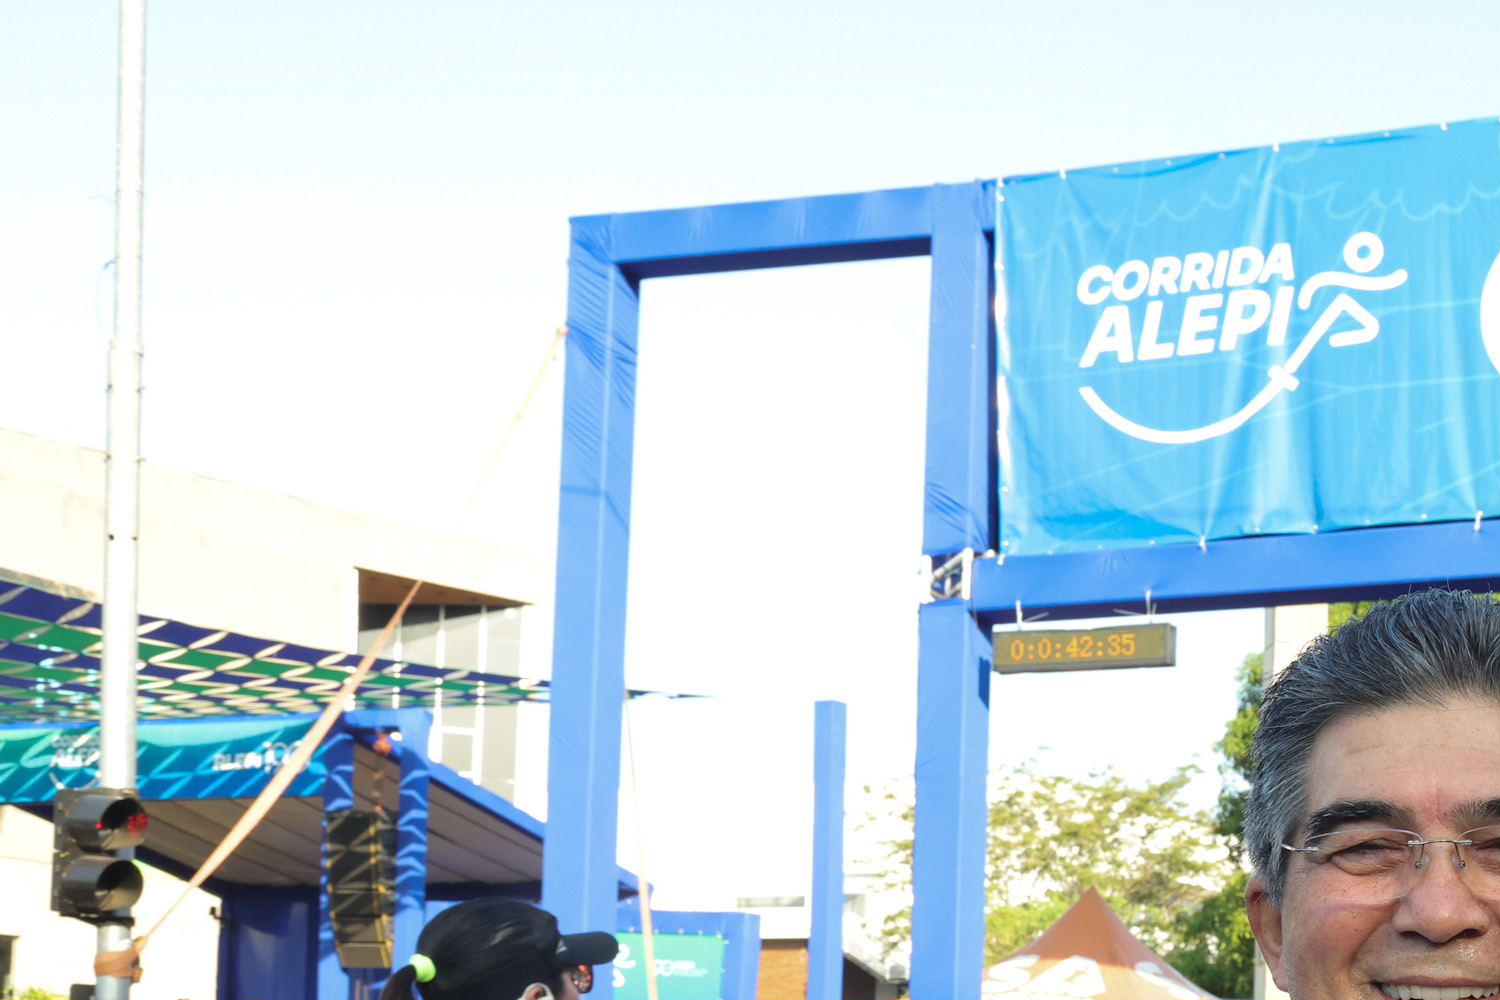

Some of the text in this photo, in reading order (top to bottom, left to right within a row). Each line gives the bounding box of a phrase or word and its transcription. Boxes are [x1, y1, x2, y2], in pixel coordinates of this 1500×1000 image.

[1077, 242, 1295, 306] CORRIDA
[1078, 286, 1295, 369] ALEPI
[1010, 633, 1137, 661] 0:0:42:35
